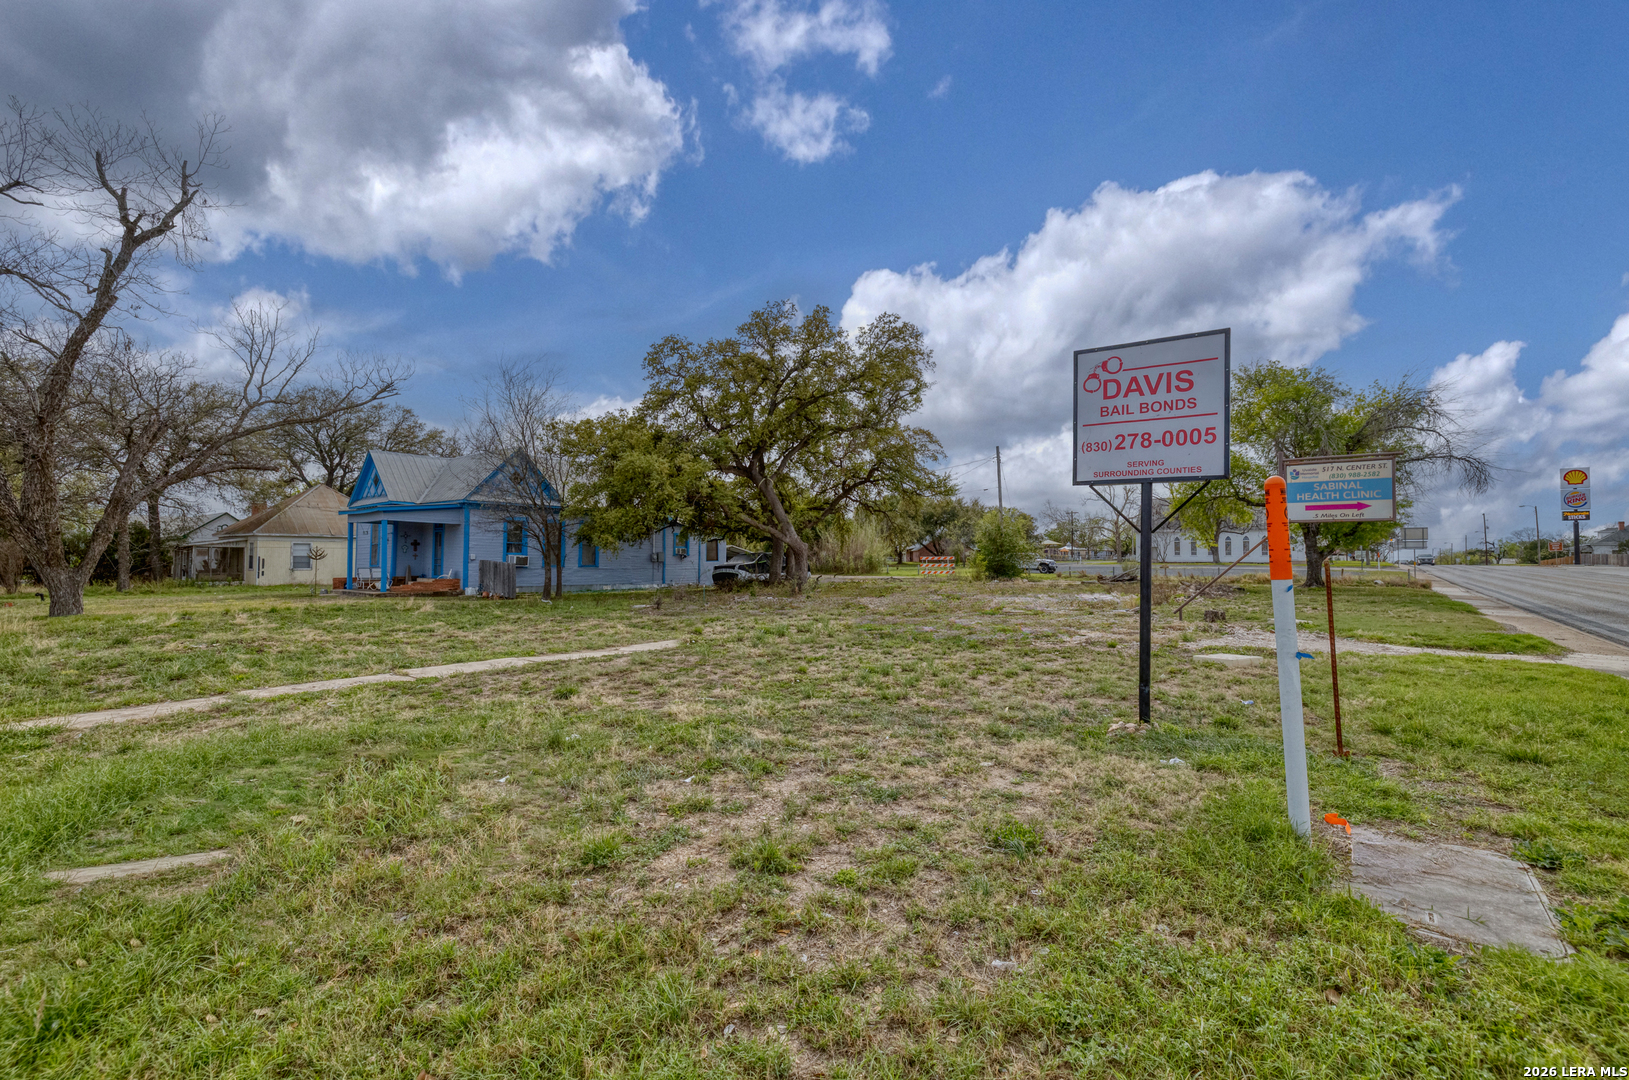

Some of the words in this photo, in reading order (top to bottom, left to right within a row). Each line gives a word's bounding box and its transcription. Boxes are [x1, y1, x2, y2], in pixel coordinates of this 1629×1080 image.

[1102, 369, 1195, 400] DAVIS
[1100, 403, 1135, 418] BAIL
[1139, 397, 1197, 414] BONDS
[1081, 439, 1113, 454] (830)
[1114, 426, 1217, 450] 278-0005
[1126, 459, 1165, 468] SERVING
[1345, 463, 1376, 471] CENTER
[1093, 468, 1155, 478] SURROUNDING
[1156, 465, 1202, 475] COUNTIES
[1328, 472, 1347, 480] (830)
[1313, 480, 1363, 491] SABINAL
[1296, 491, 1340, 501] HEALTH
[1343, 489, 1382, 499] CLINIC
[1567, 496, 1587, 505] KING
